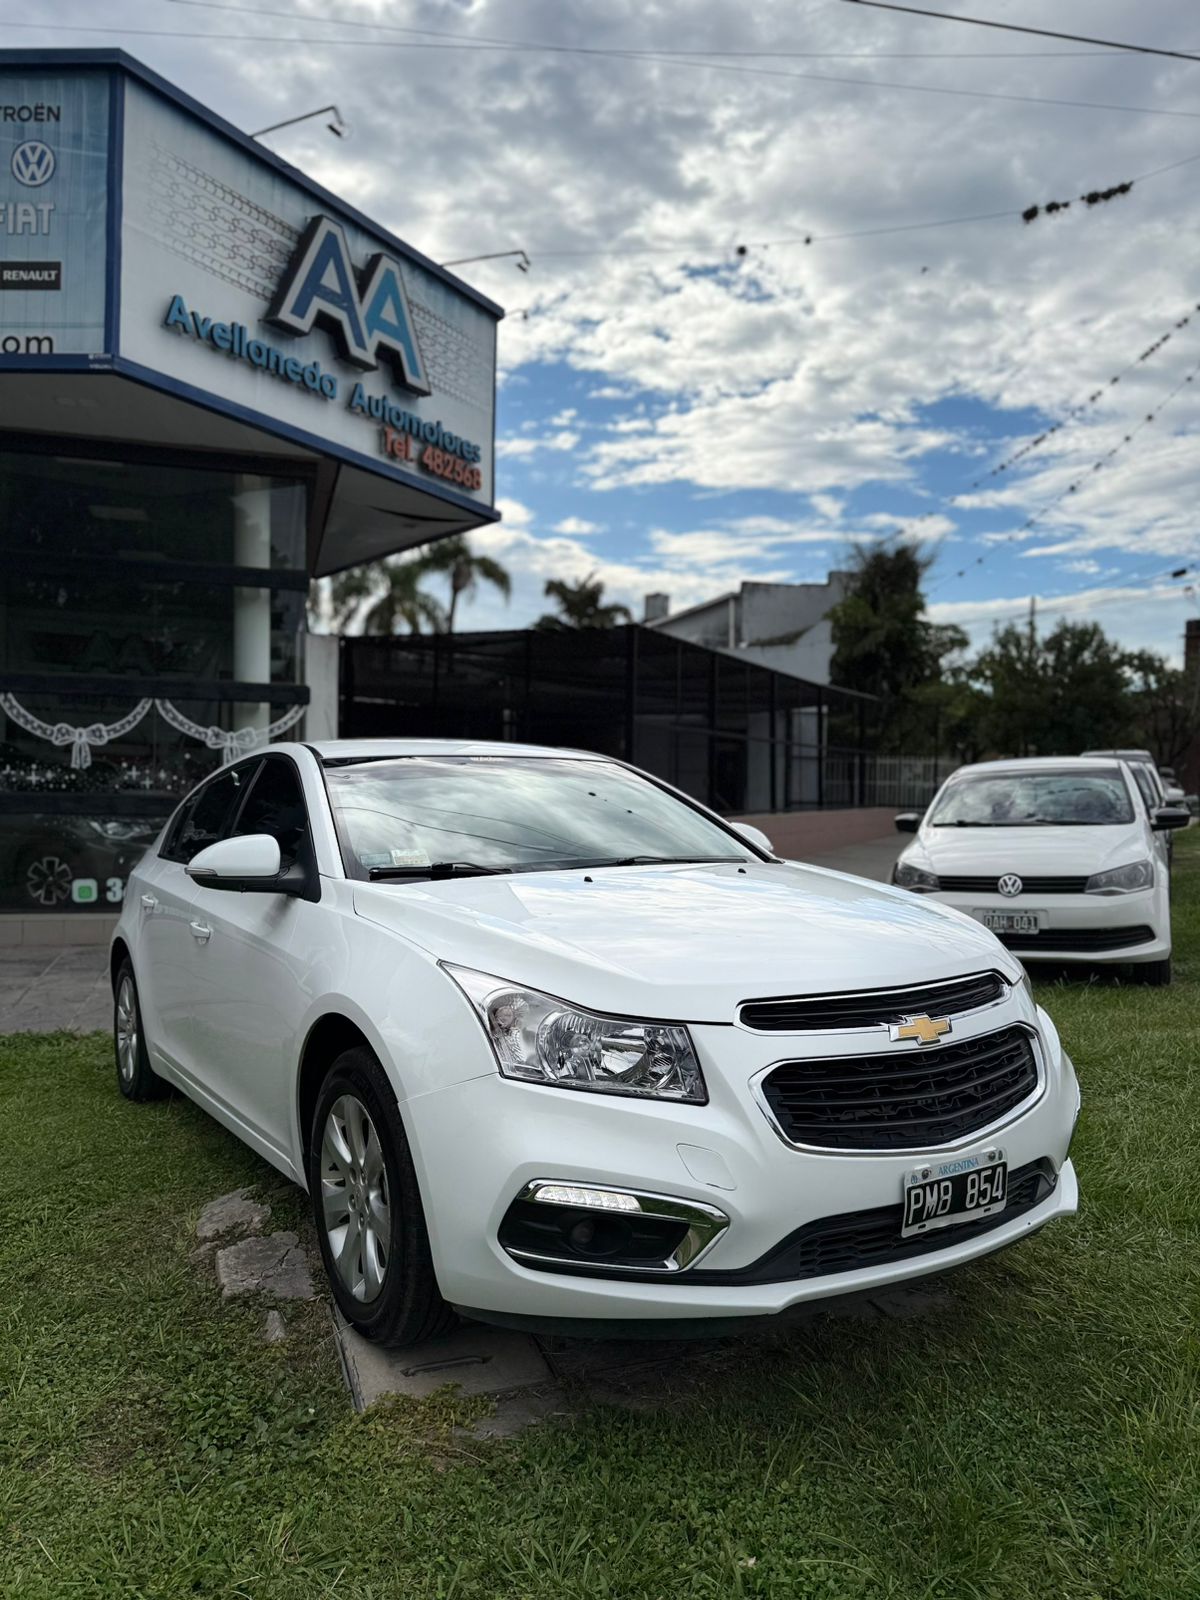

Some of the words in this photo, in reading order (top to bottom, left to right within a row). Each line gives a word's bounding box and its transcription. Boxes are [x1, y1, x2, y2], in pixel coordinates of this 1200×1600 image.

[0, 102, 61, 122] ROËN
[2, 269, 58, 281] RENAULT
[264, 214, 431, 396] AA
[165, 294, 337, 399] Avellaneda
[351, 382, 480, 463] Automotores
[422, 444, 482, 490] 482568
[938, 1157, 979, 1176] ARGENTINA
[908, 1180, 952, 1225] PMB
[965, 1165, 1004, 1209] 854
